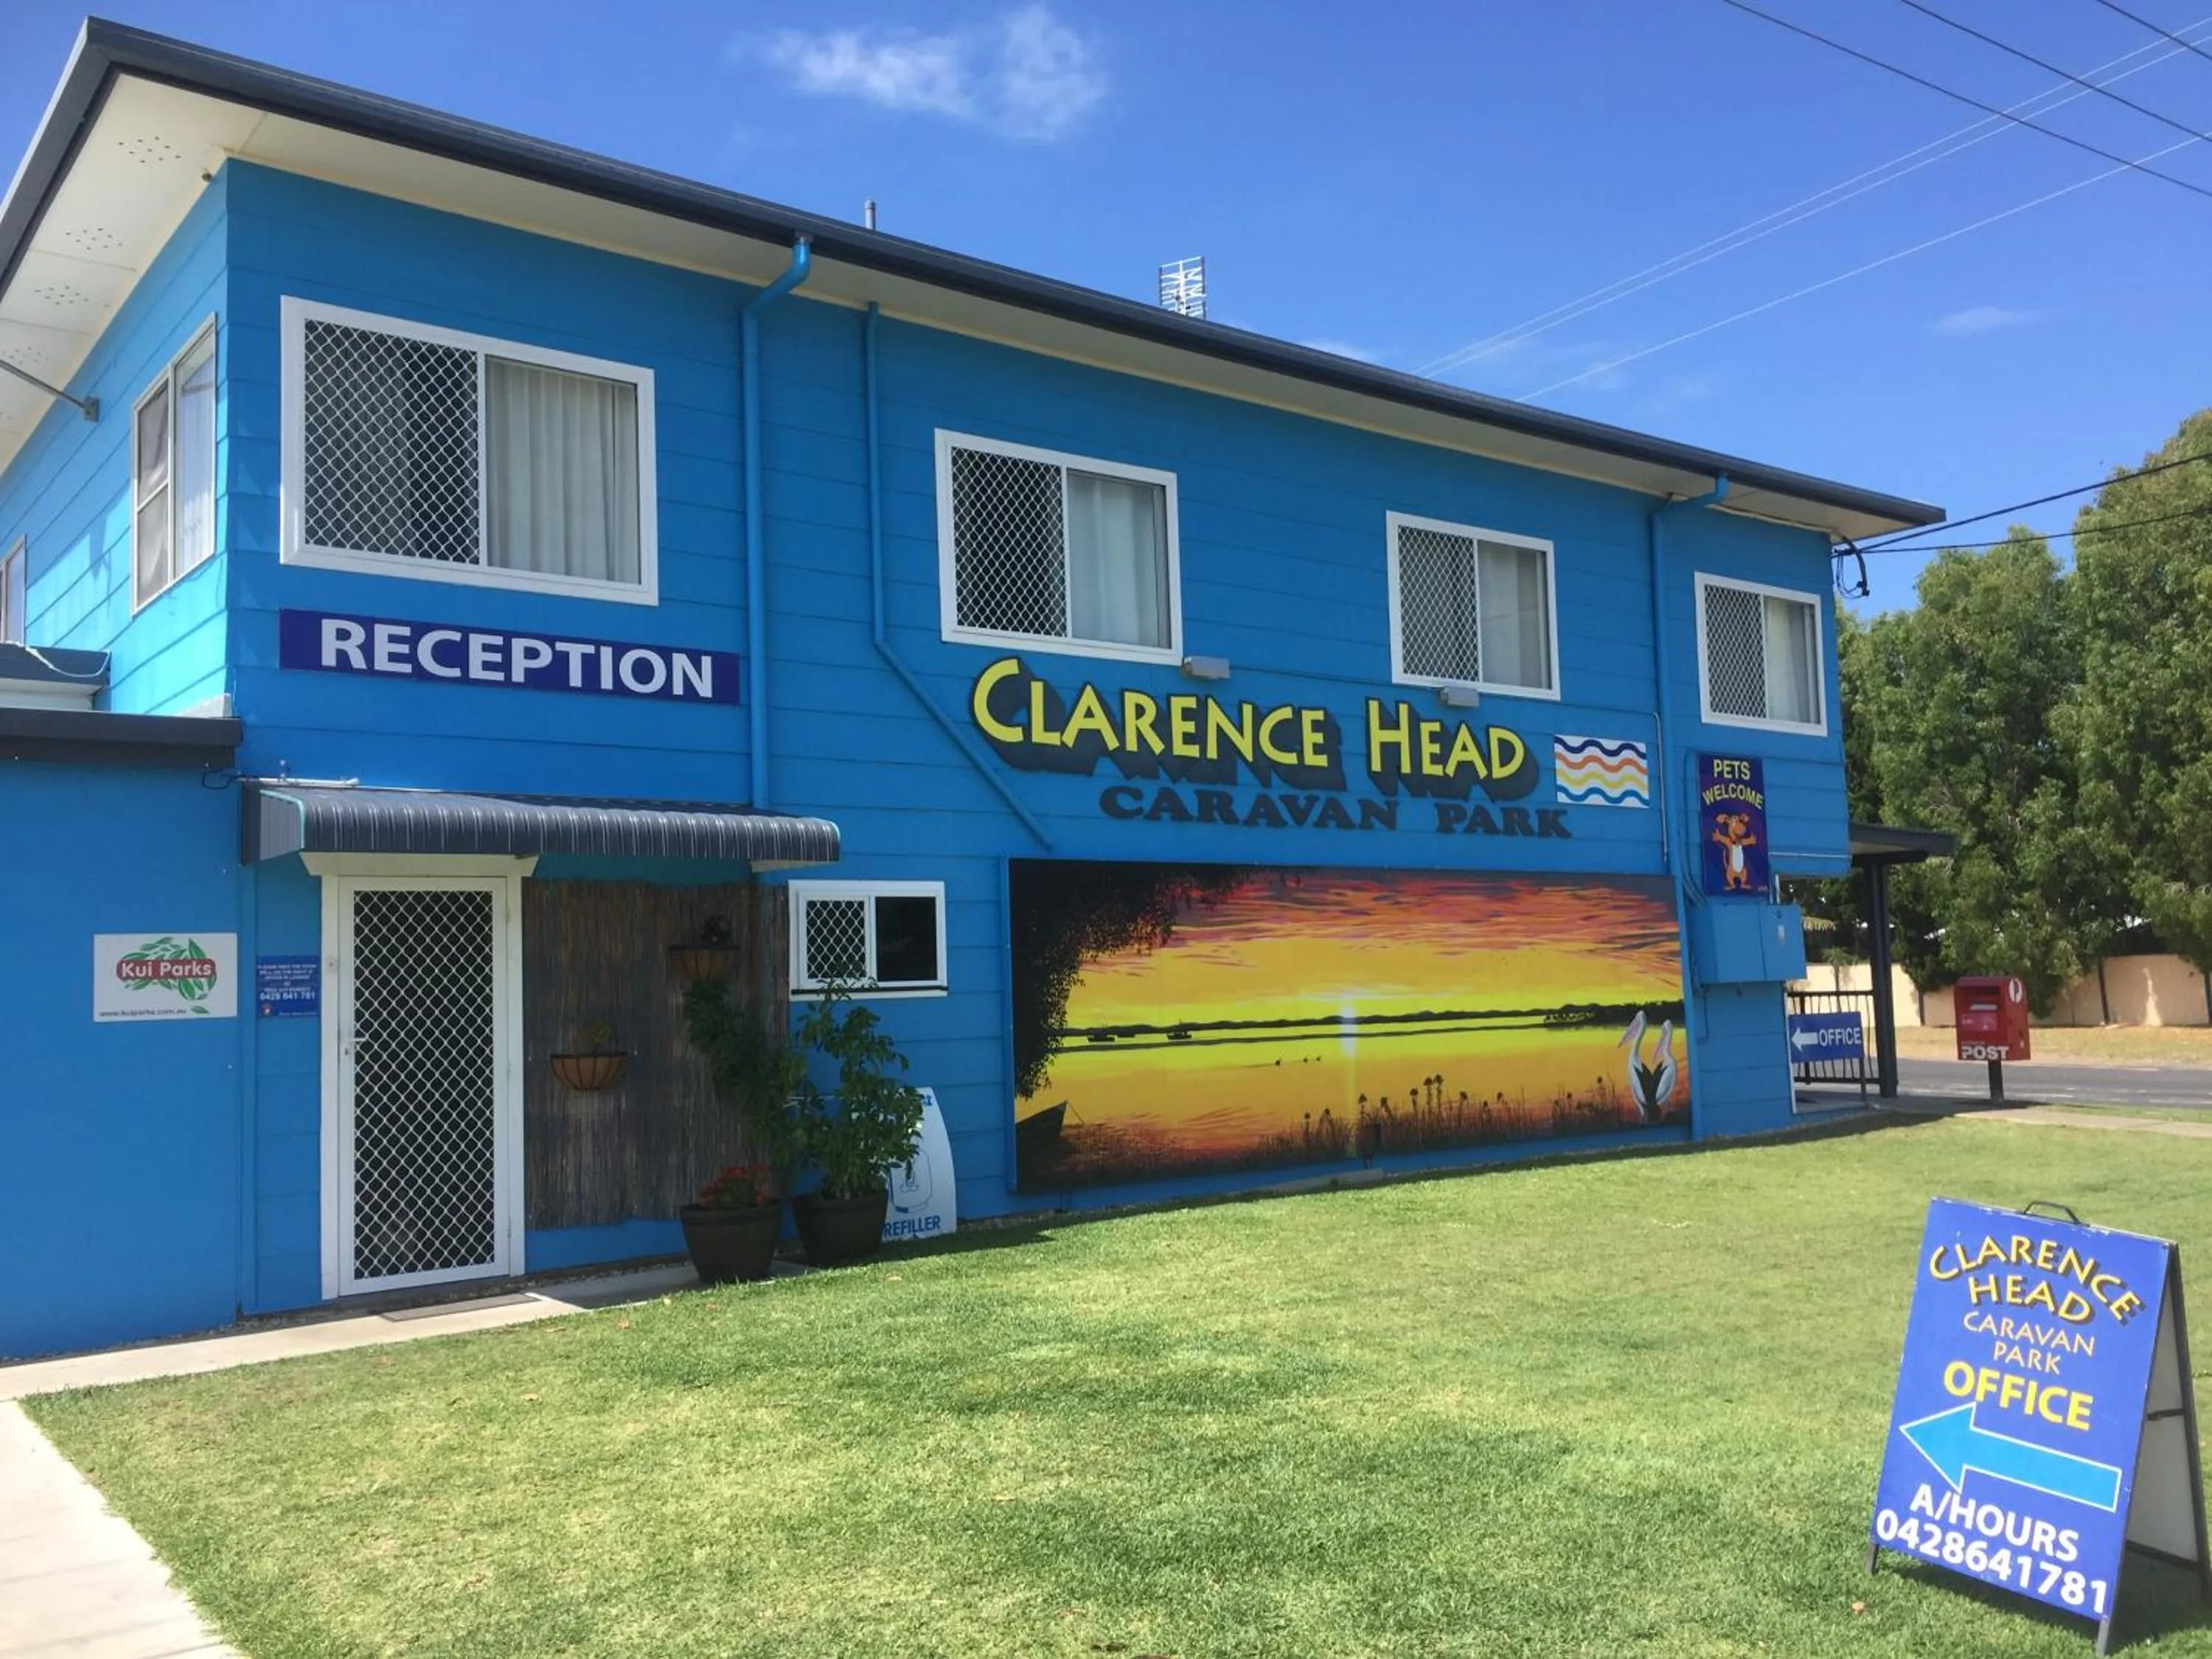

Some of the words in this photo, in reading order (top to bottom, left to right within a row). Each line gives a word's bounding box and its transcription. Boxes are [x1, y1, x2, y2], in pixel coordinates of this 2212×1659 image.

[321, 618, 712, 698] RECEPTION
[971, 656, 1329, 768] CLARENCE
[1366, 698, 1527, 780] HEAD
[1714, 759, 1750, 780] PETS
[1099, 786, 1398, 831] CARAVAN
[1434, 802, 1572, 838] PARK
[1703, 783, 1764, 810] WELCOME
[121, 961, 152, 977] Kui
[160, 961, 212, 975] Parks
[1818, 1027, 1862, 1047] OFFICE
[1961, 1046, 2009, 1060] POST
[885, 1214, 941, 1237] REFILLER
[1930, 1235, 2143, 1322] CLARENCE
[1968, 1273, 2094, 1324] HEAD
[1963, 1311, 2096, 1357] CARAVAN
[1993, 1345, 2062, 1375] PARK
[1944, 1360, 2094, 1432] OFFICE
[1910, 1484, 2079, 1562] A/HOURS
[1877, 1509, 2108, 1614] 0428641781
